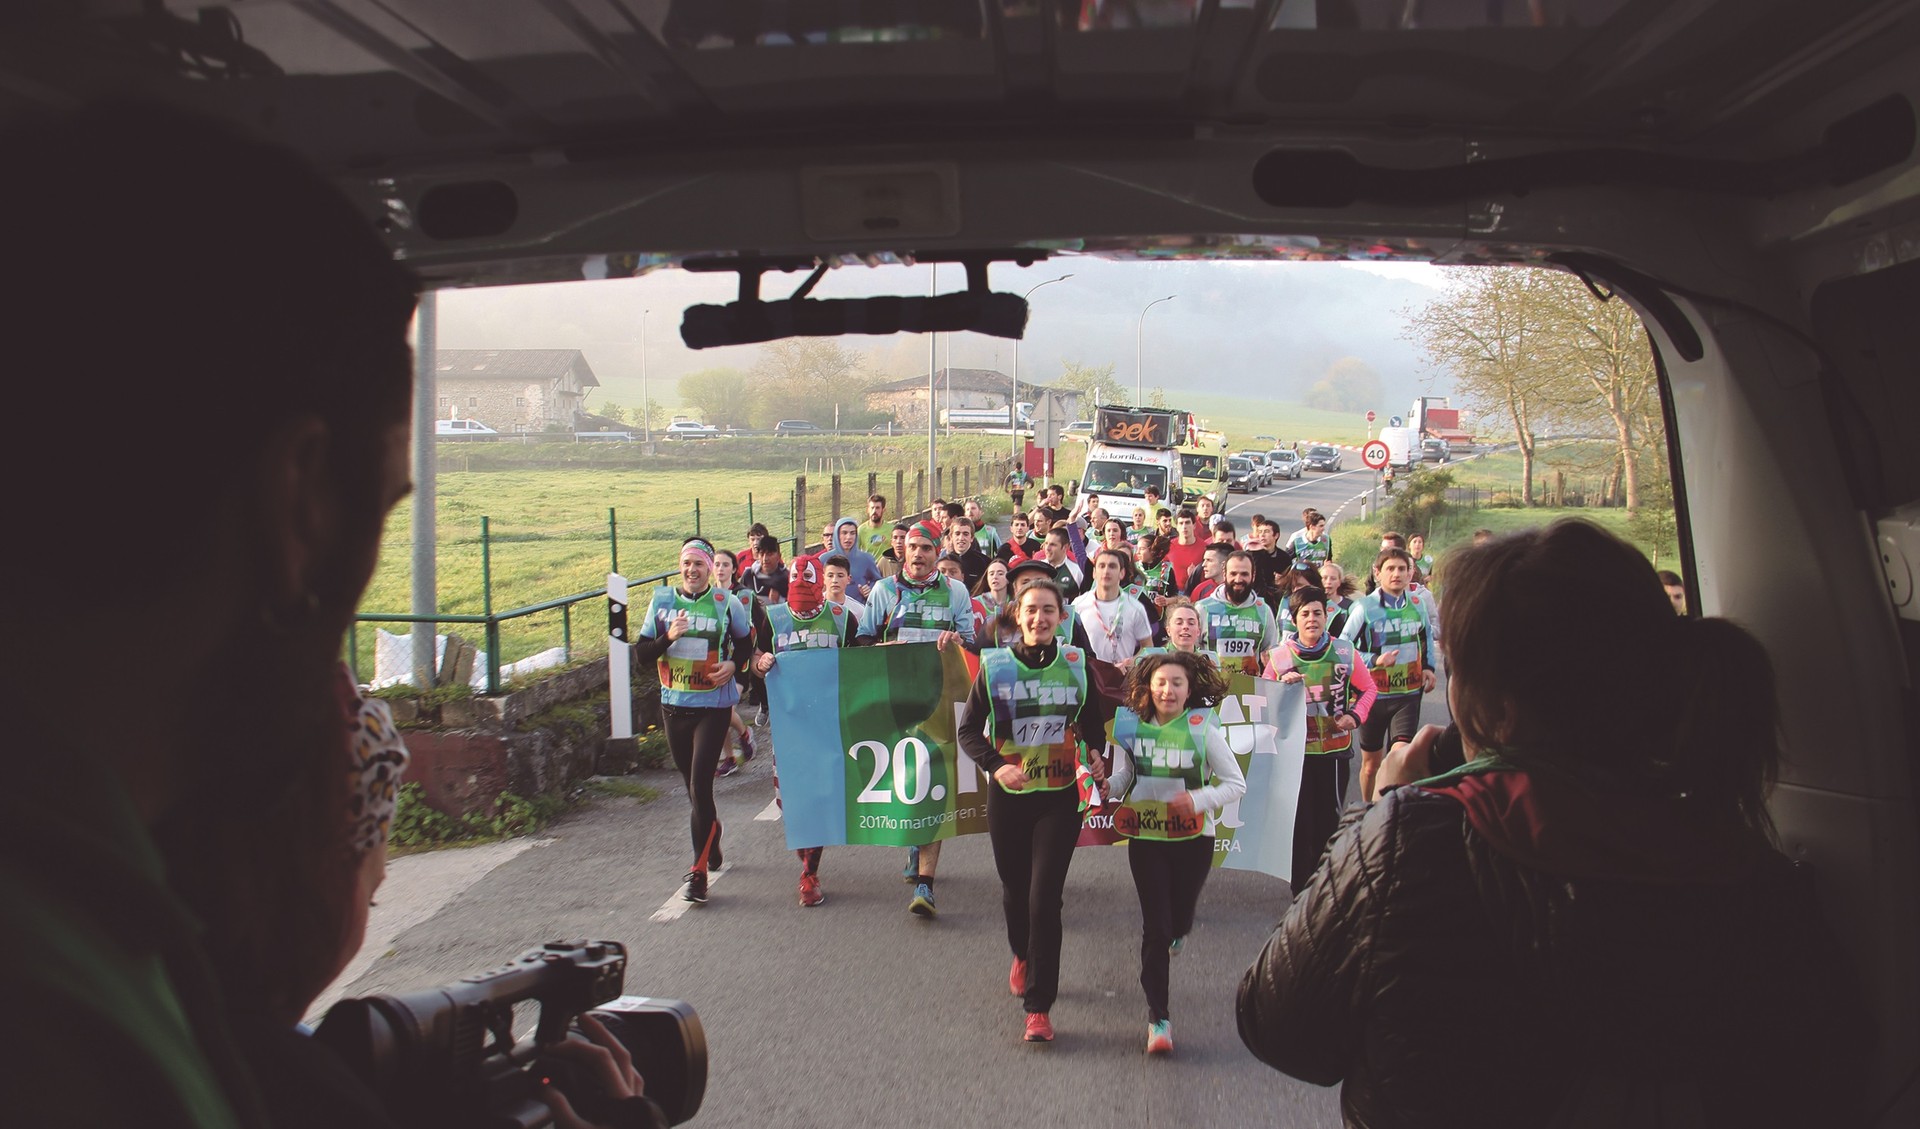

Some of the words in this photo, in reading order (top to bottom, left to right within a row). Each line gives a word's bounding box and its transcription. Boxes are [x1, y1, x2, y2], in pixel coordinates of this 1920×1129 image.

[1108, 415, 1158, 443] aek
[1367, 449, 1385, 459] 40
[1211, 614, 1238, 627] BAT
[1236, 619, 1261, 634] ZUK
[778, 629, 809, 648] BAT
[806, 633, 839, 648] ZUK
[1224, 640, 1250, 654] 1997
[1038, 686, 1079, 706] ZUK
[1218, 694, 1268, 724] AT
[1151, 747, 1195, 769] ZUK
[859, 815, 897, 830] 2017ko
[899, 806, 977, 830] martxoaren
[1214, 839, 1242, 853] ERA
